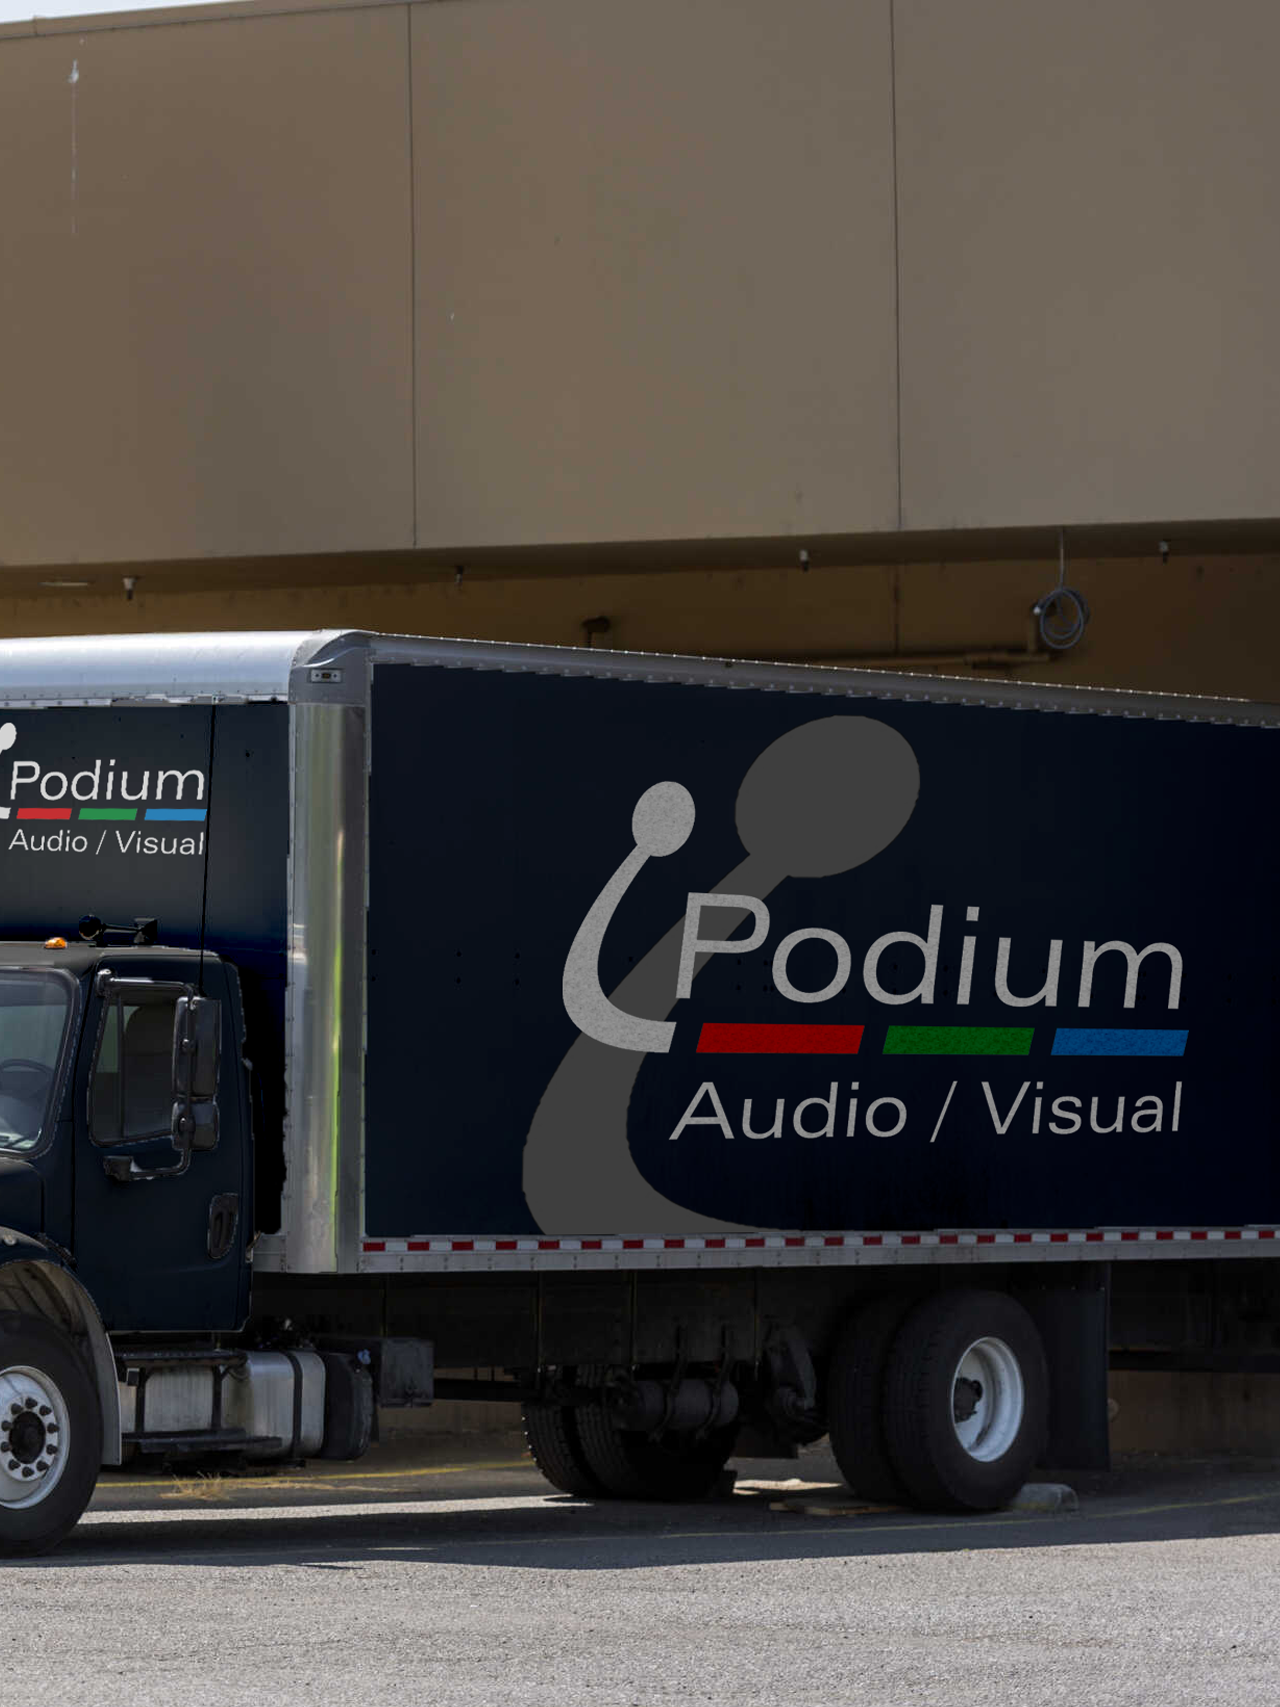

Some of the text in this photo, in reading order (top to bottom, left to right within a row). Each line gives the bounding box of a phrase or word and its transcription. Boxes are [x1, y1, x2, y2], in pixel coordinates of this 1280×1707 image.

[10, 759, 205, 801] Podium
[8, 829, 205, 856] Audio / Visual
[675, 892, 1183, 1010] Podium
[669, 1081, 1182, 1143] Audio / Visual
